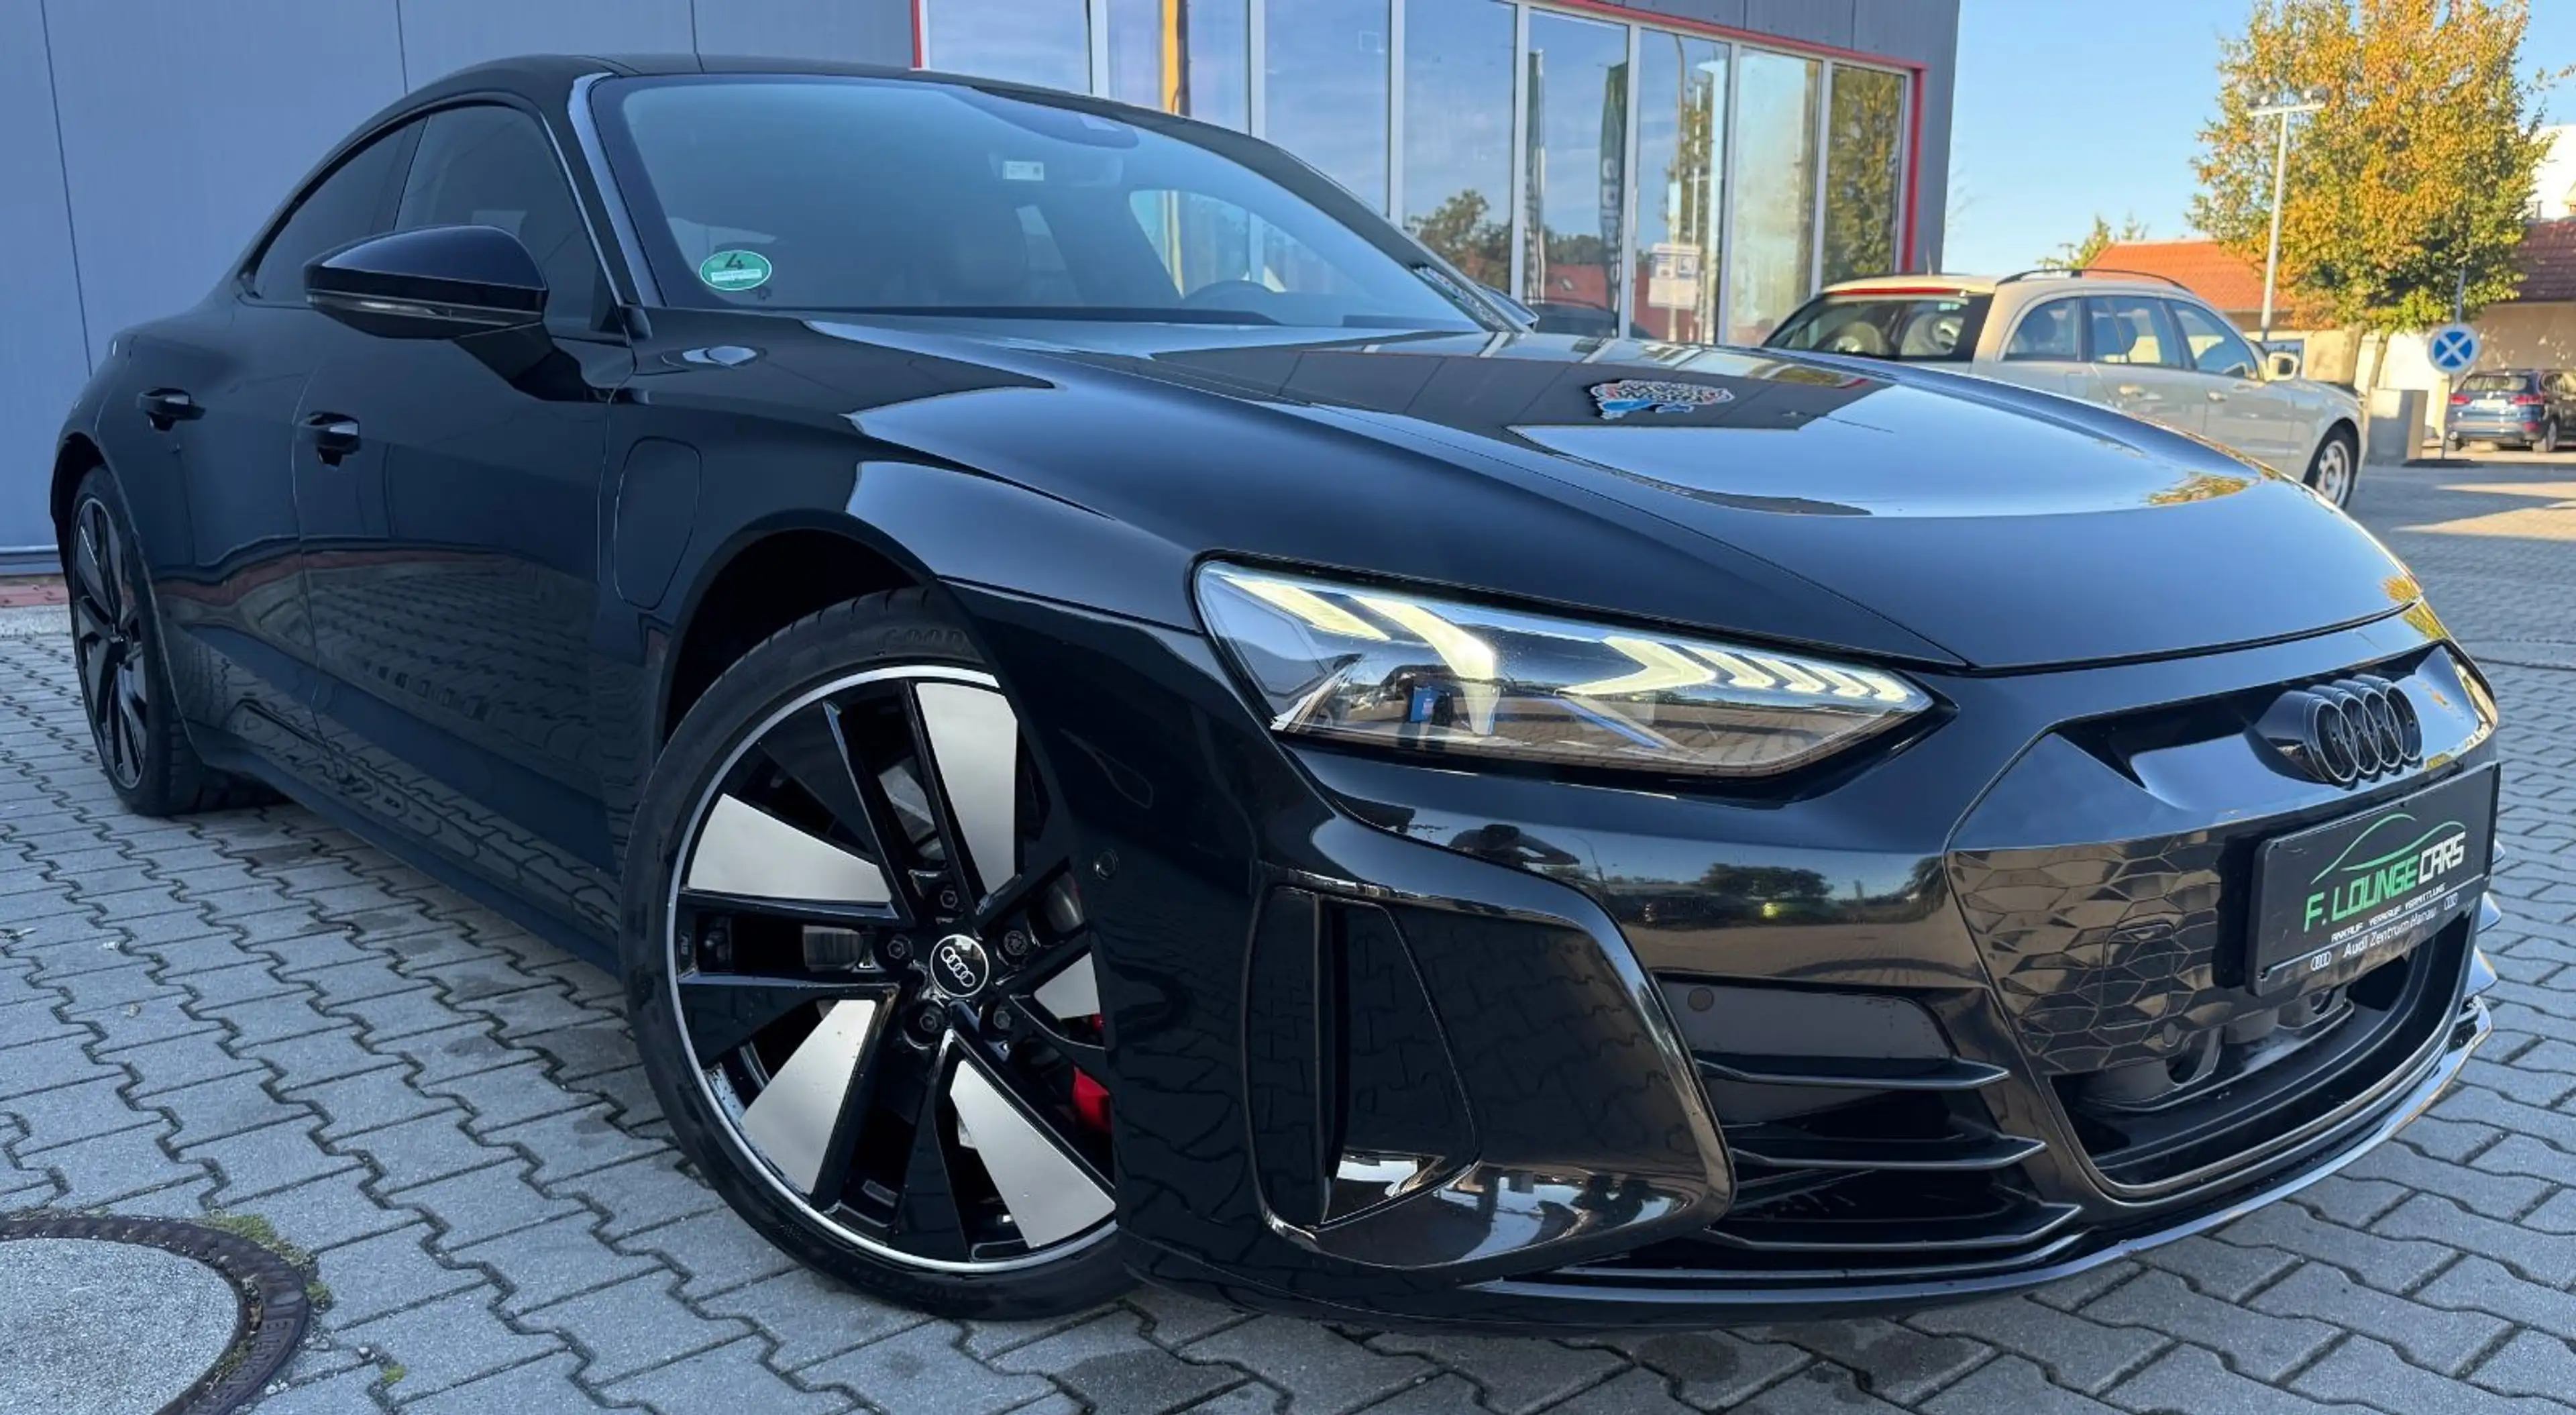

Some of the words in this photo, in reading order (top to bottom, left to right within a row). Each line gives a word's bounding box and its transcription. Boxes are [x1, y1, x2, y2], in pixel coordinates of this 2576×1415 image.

[724, 254, 744, 270] 4
[2343, 935, 2368, 958] Audi
[2369, 920, 2410, 947] Zentrum
[2410, 906, 2437, 929] Hanau
